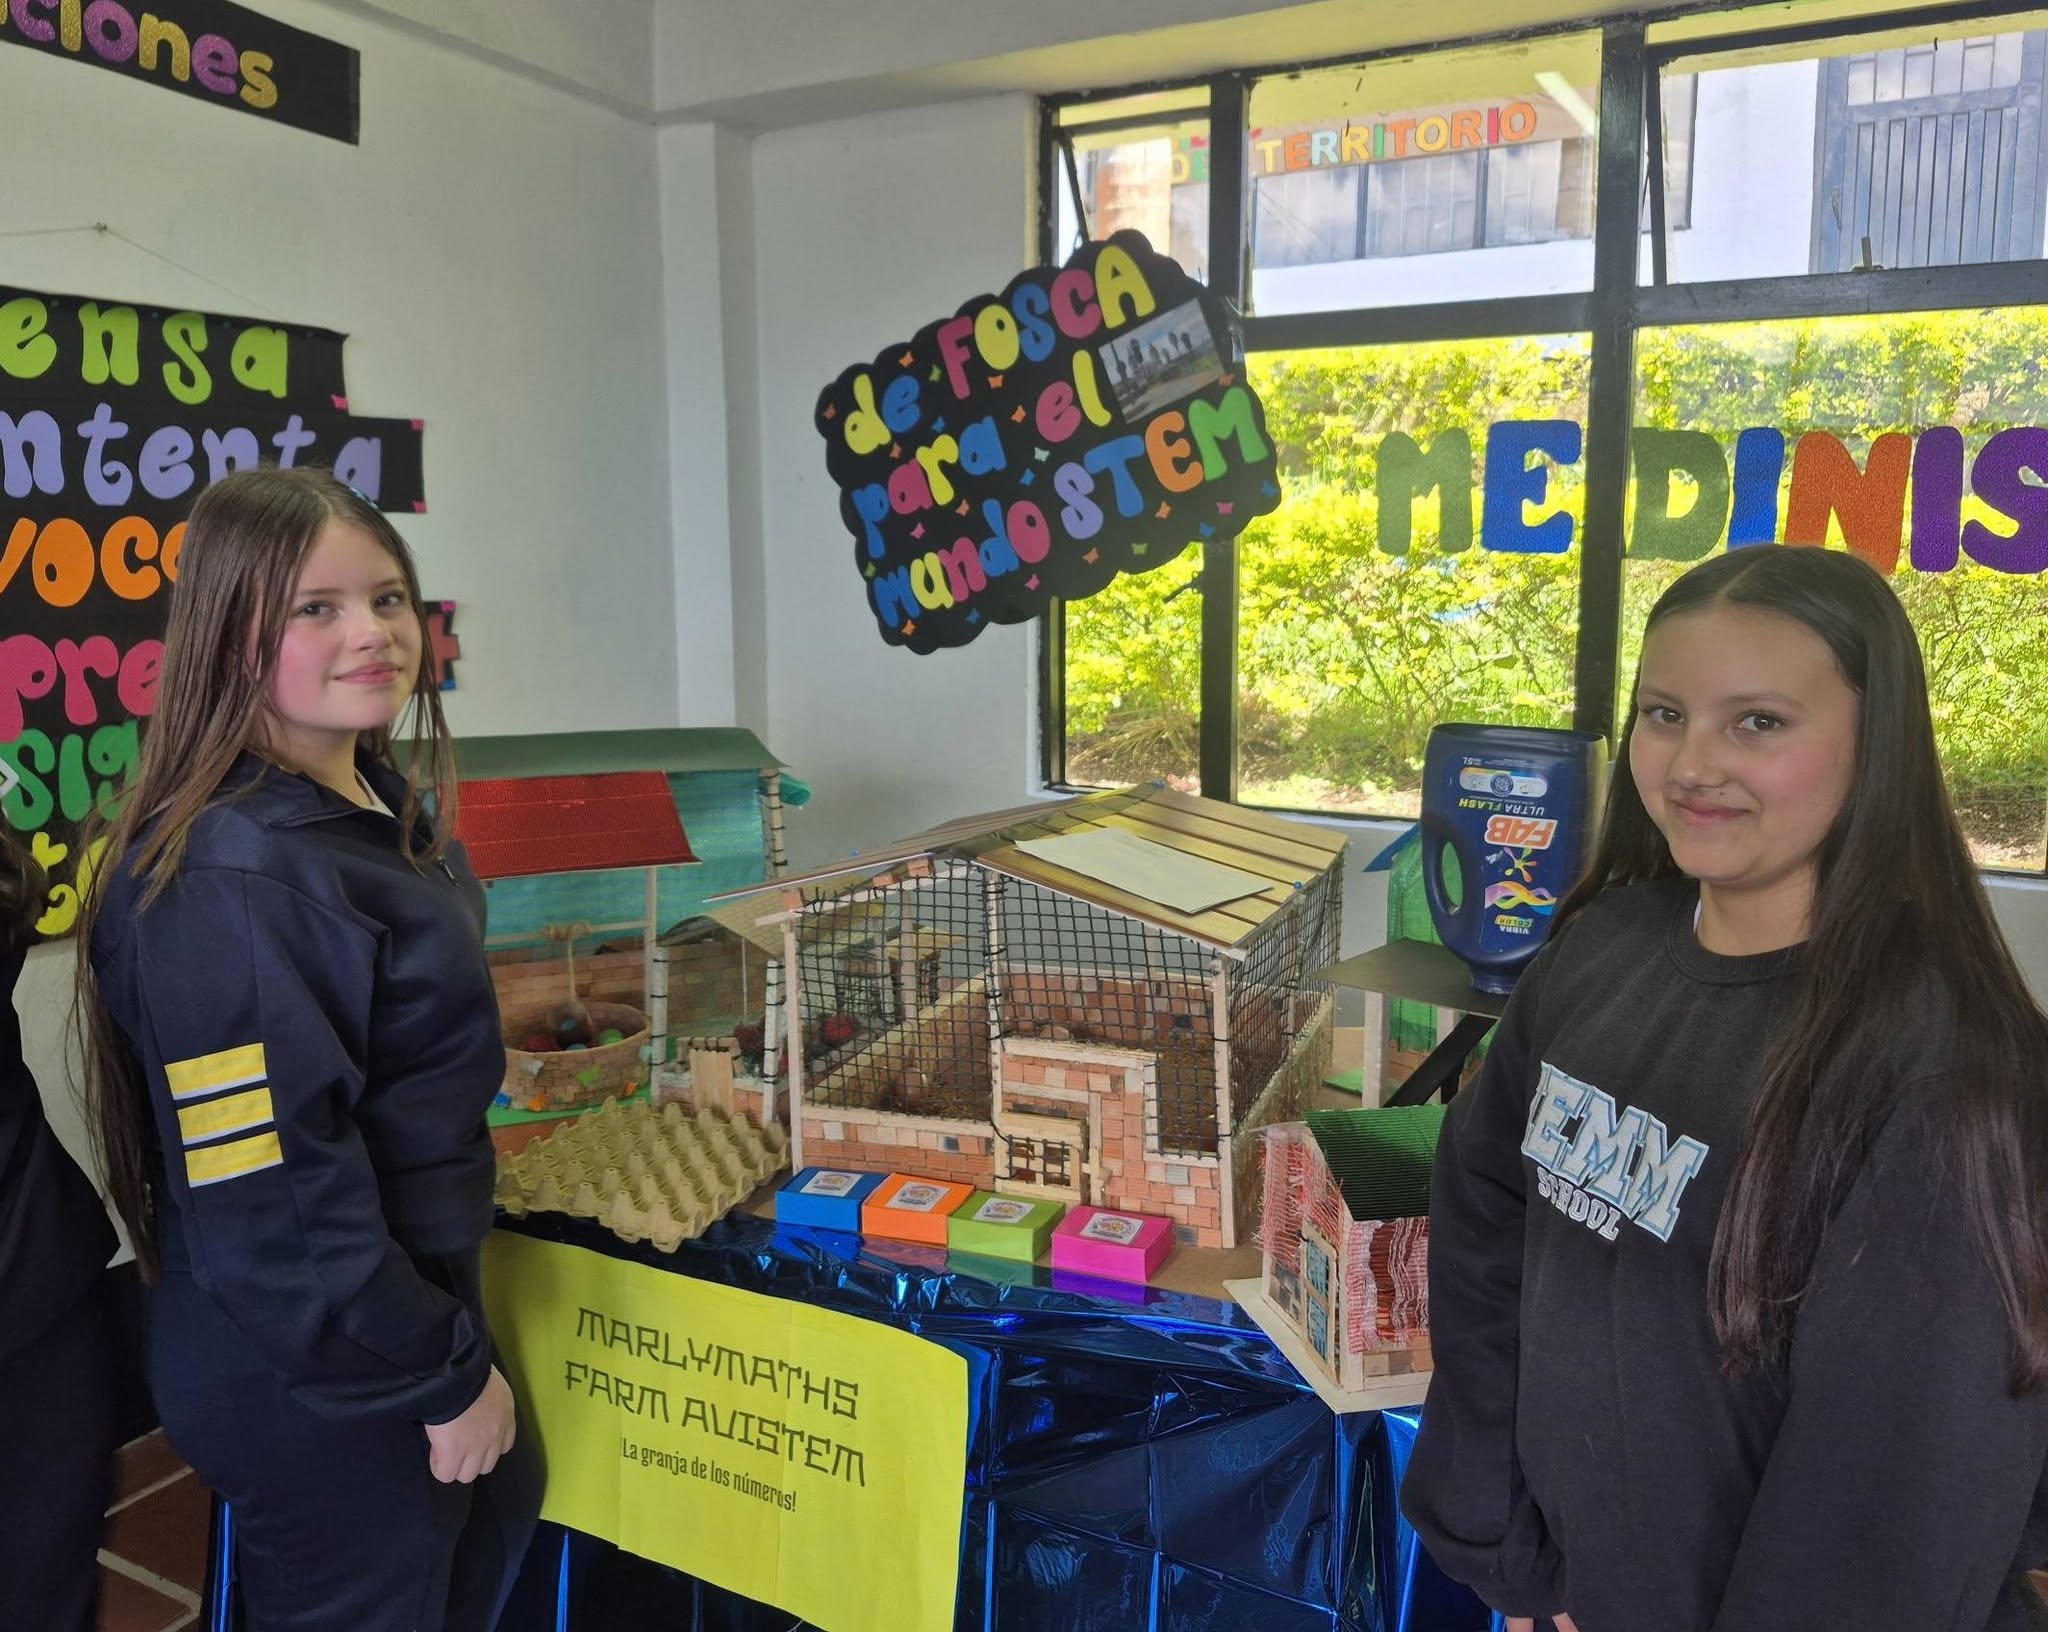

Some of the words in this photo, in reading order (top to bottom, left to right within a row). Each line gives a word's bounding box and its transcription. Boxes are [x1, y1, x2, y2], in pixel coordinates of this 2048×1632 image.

[0, 0, 278, 109] ciones
[1255, 102, 1537, 174] TERRITORIO
[844, 374, 922, 455] de
[937, 245, 1156, 399] FOSCA
[852, 416, 1006, 558] para
[1035, 350, 1112, 443] el
[874, 499, 1050, 627] mundo
[1054, 386, 1268, 540] STEM
[1458, 797, 1502, 810] FLASH
[1486, 815, 1556, 849] FAB
[1505, 803, 1544, 815] ULTRA
[1498, 916, 1532, 927] COLOR
[1499, 925, 1530, 935] VIBRA
[1520, 1060, 1710, 1244] EMM
[577, 1307, 859, 1420] MARLYMATHS
[565, 1360, 670, 1423] FARM
[681, 1396, 866, 1487] AVISTEM
[641, 1451, 688, 1476] granja
[691, 1456, 707, 1479] de
[711, 1460, 730, 1487] los
[733, 1472, 797, 1512] números!
